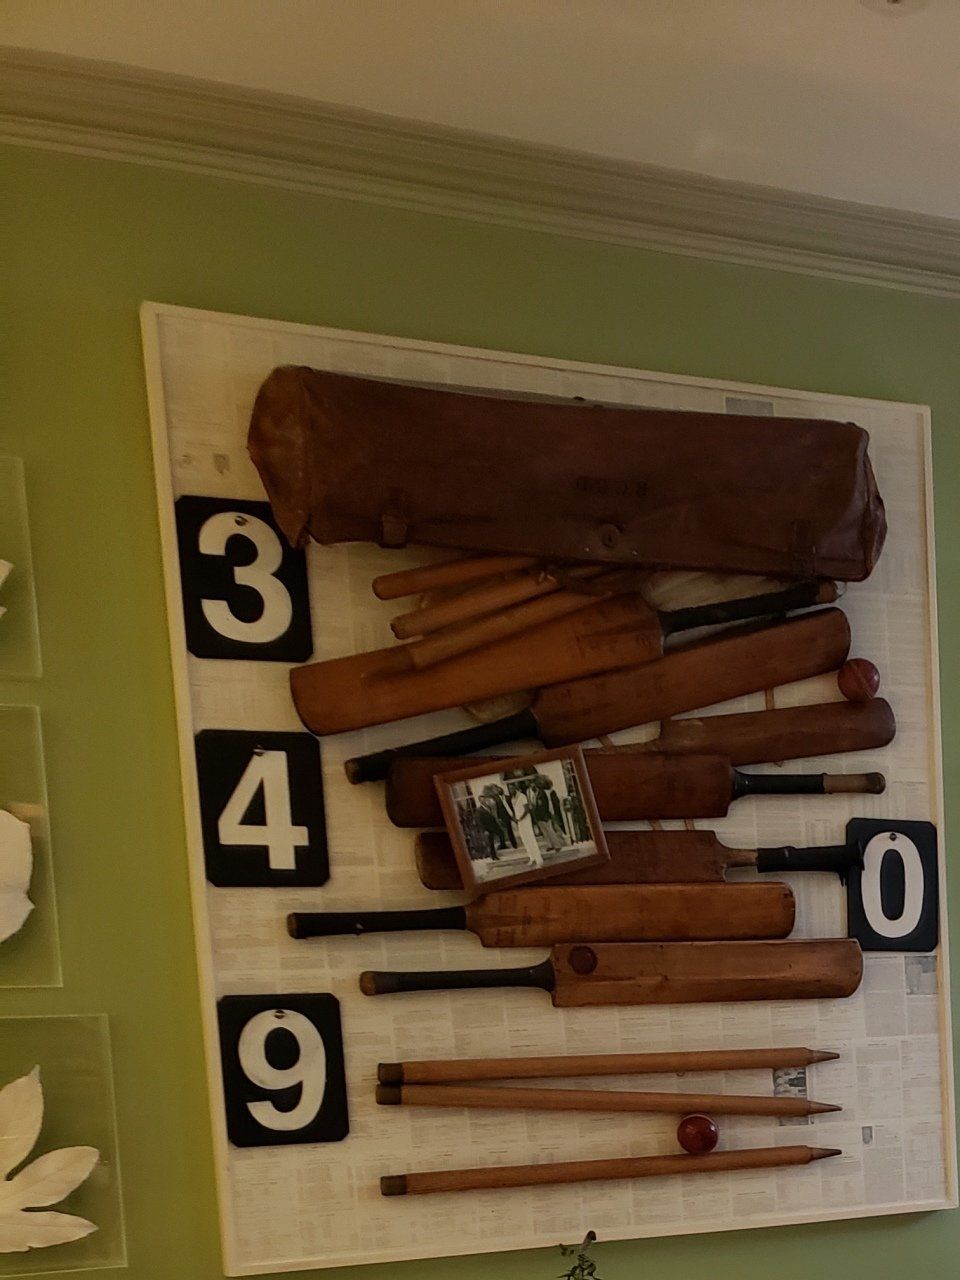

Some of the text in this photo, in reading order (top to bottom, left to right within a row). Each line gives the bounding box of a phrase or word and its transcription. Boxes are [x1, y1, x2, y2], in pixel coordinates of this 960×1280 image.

[199, 512, 292, 642] 3
[218, 749, 309, 869] 4
[861, 831, 925, 938] 0
[239, 1010, 326, 1131] 9
